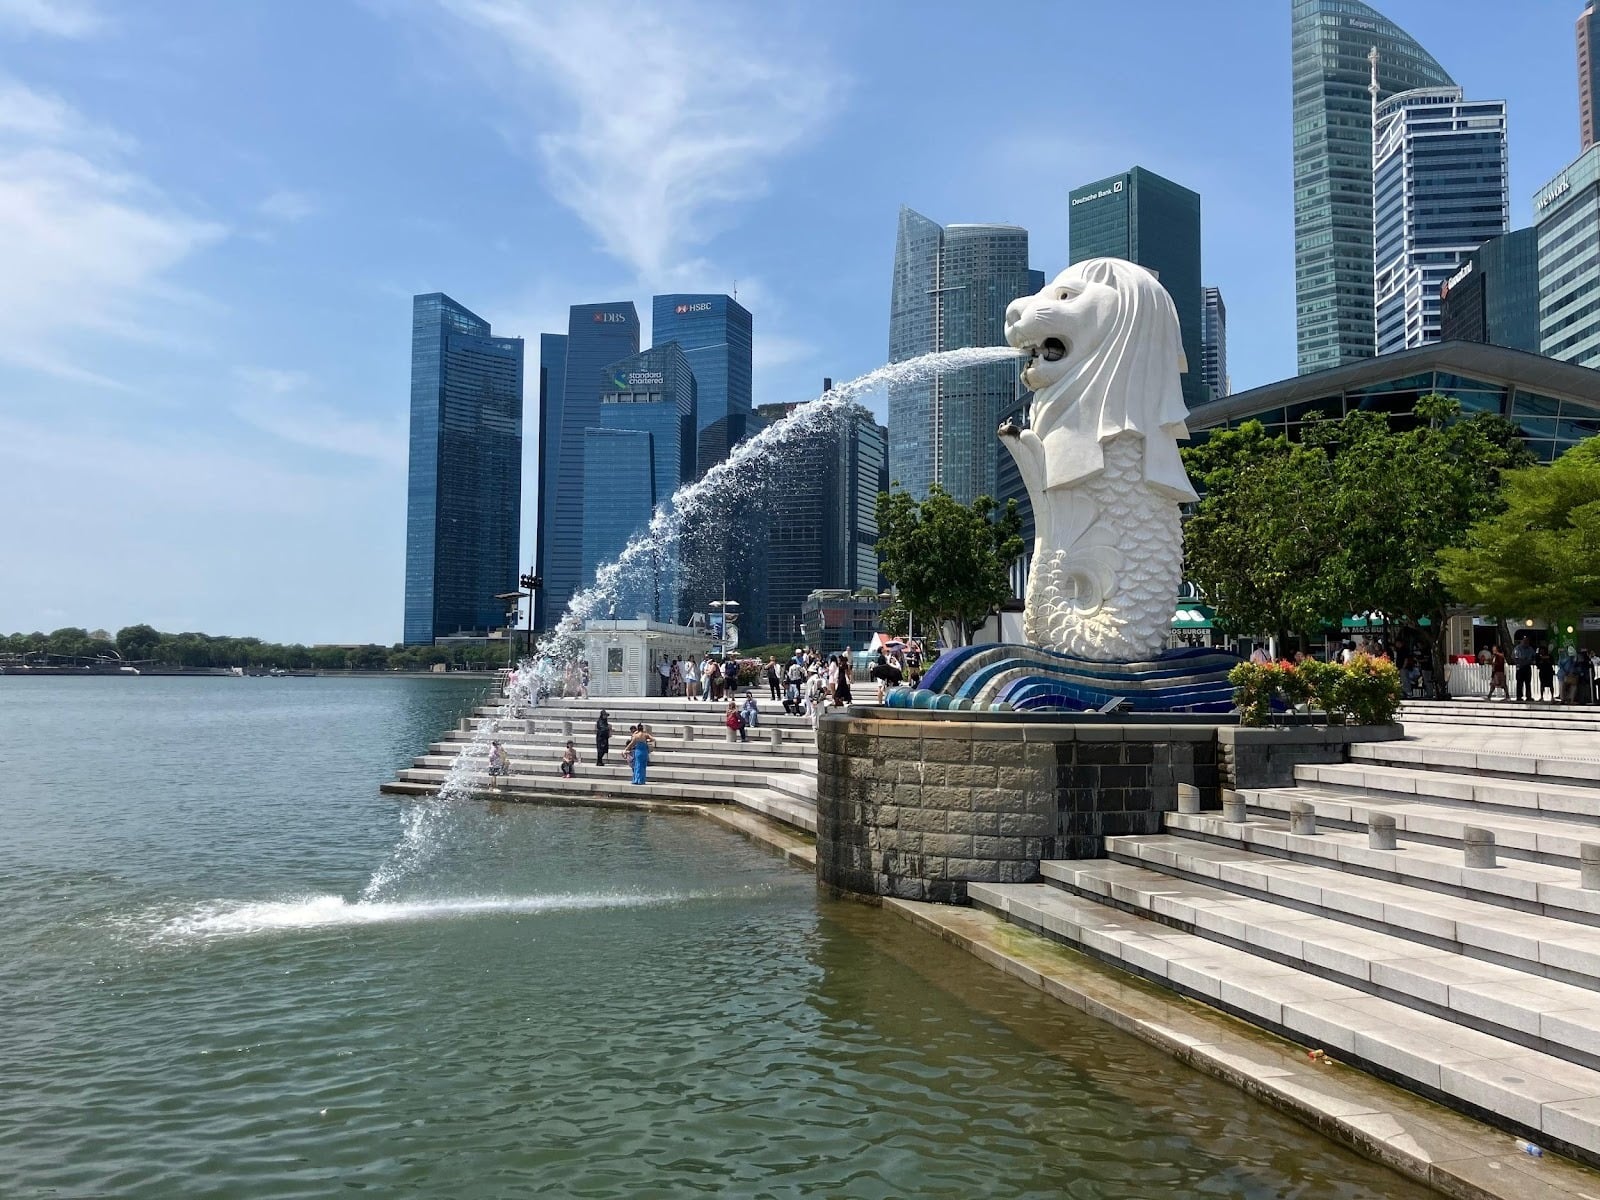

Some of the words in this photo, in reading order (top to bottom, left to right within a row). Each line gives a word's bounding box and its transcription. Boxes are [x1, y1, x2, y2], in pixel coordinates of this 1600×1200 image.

[1349, 18, 1375, 29] Keppel
[1072, 193, 1097, 206] Deutsche
[1098, 189, 1112, 198] Bank
[690, 302, 712, 311] HSBC
[604, 312, 626, 322] DBS
